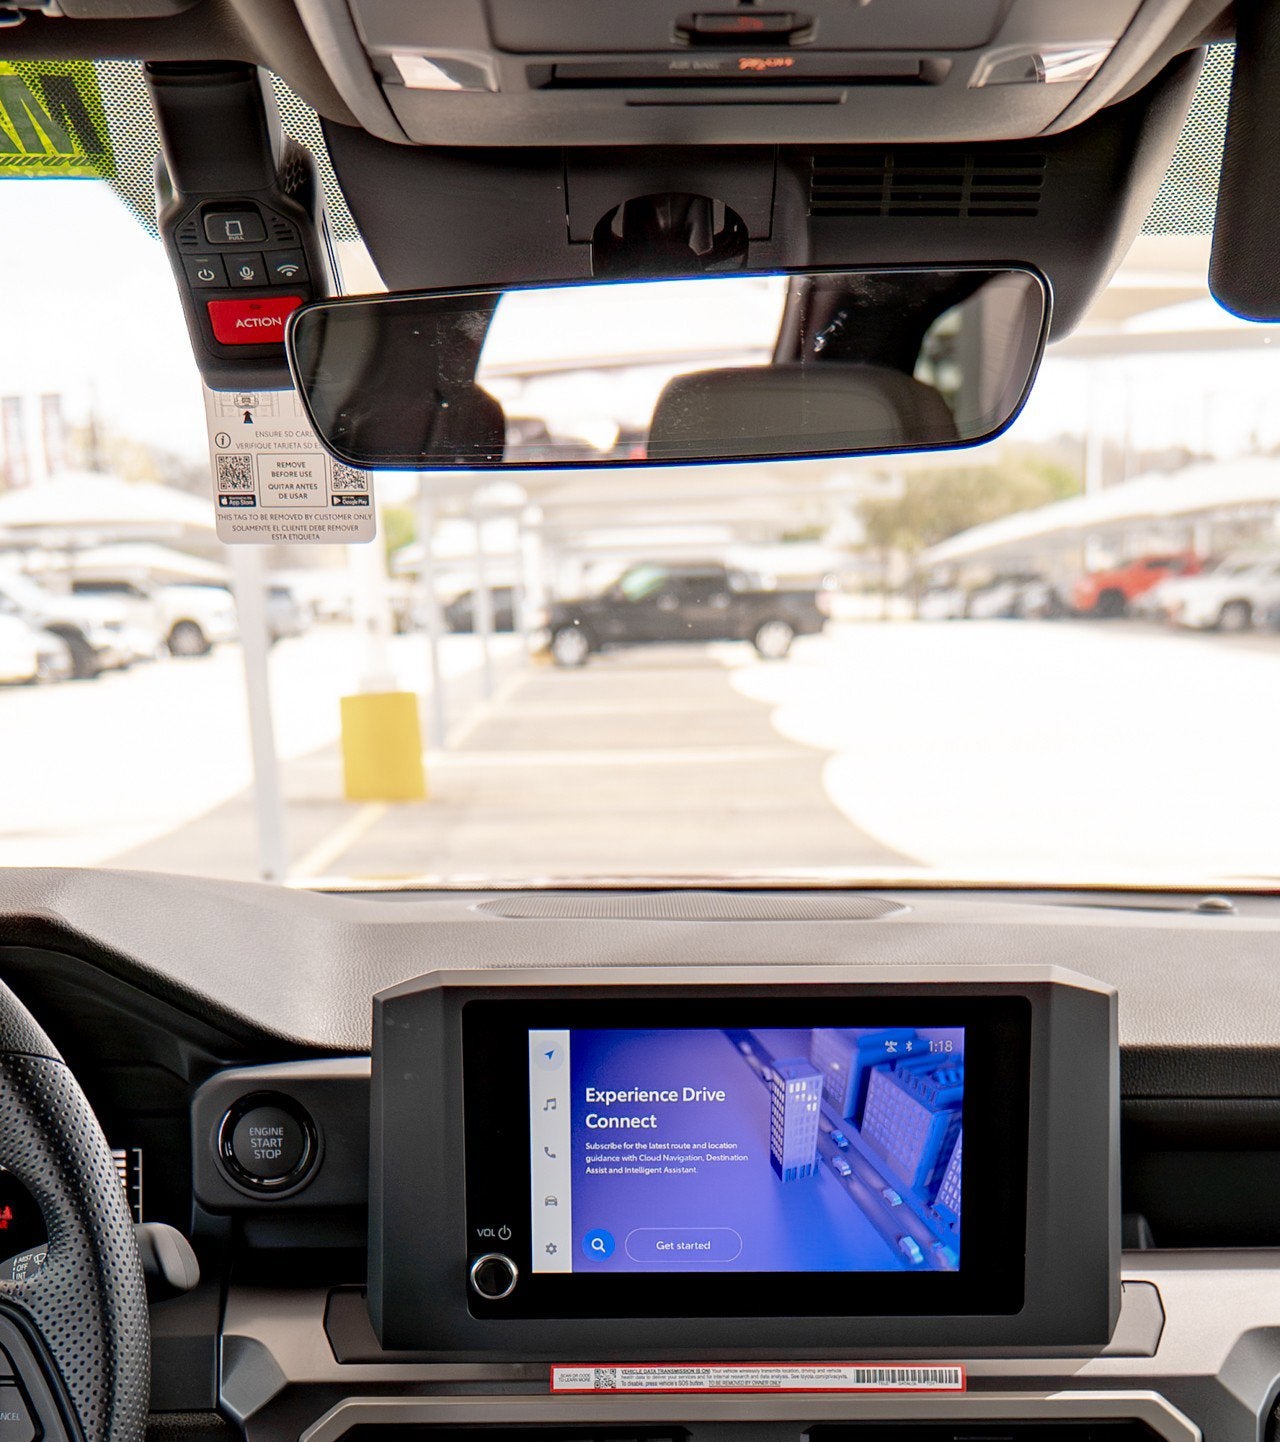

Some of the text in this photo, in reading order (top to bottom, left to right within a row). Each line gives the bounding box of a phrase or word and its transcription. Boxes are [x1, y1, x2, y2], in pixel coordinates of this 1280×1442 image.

[235, 316, 282, 328] ACTION
[236, 442, 272, 450] VERIFIQUE
[274, 442, 303, 450] TARJETA
[342, 499, 358, 507] Google
[928, 1040, 953, 1053] 1:18
[585, 1087, 726, 1106] Experience Drive
[585, 1114, 658, 1129] Connect
[249, 1127, 284, 1136] ENGINE
[250, 1138, 283, 1148] START
[585, 1142, 738, 1150] Subscribe for the latest route and location
[254, 1149, 282, 1159] STOP
[585, 1155, 620, 1163] guidance
[621, 1154, 638, 1162] with
[639, 1154, 662, 1162] Cloud
[706, 1154, 749, 1162] Destination
[585, 1166, 608, 1174] Assist
[609, 1166, 623, 1174] and
[624, 1166, 662, 1176] Intelligent
[477, 1228, 496, 1238] VOL
[656, 1240, 711, 1250] Get started
[16, 1264, 29, 1272] OFF
[15, 1272, 27, 1280] INT
